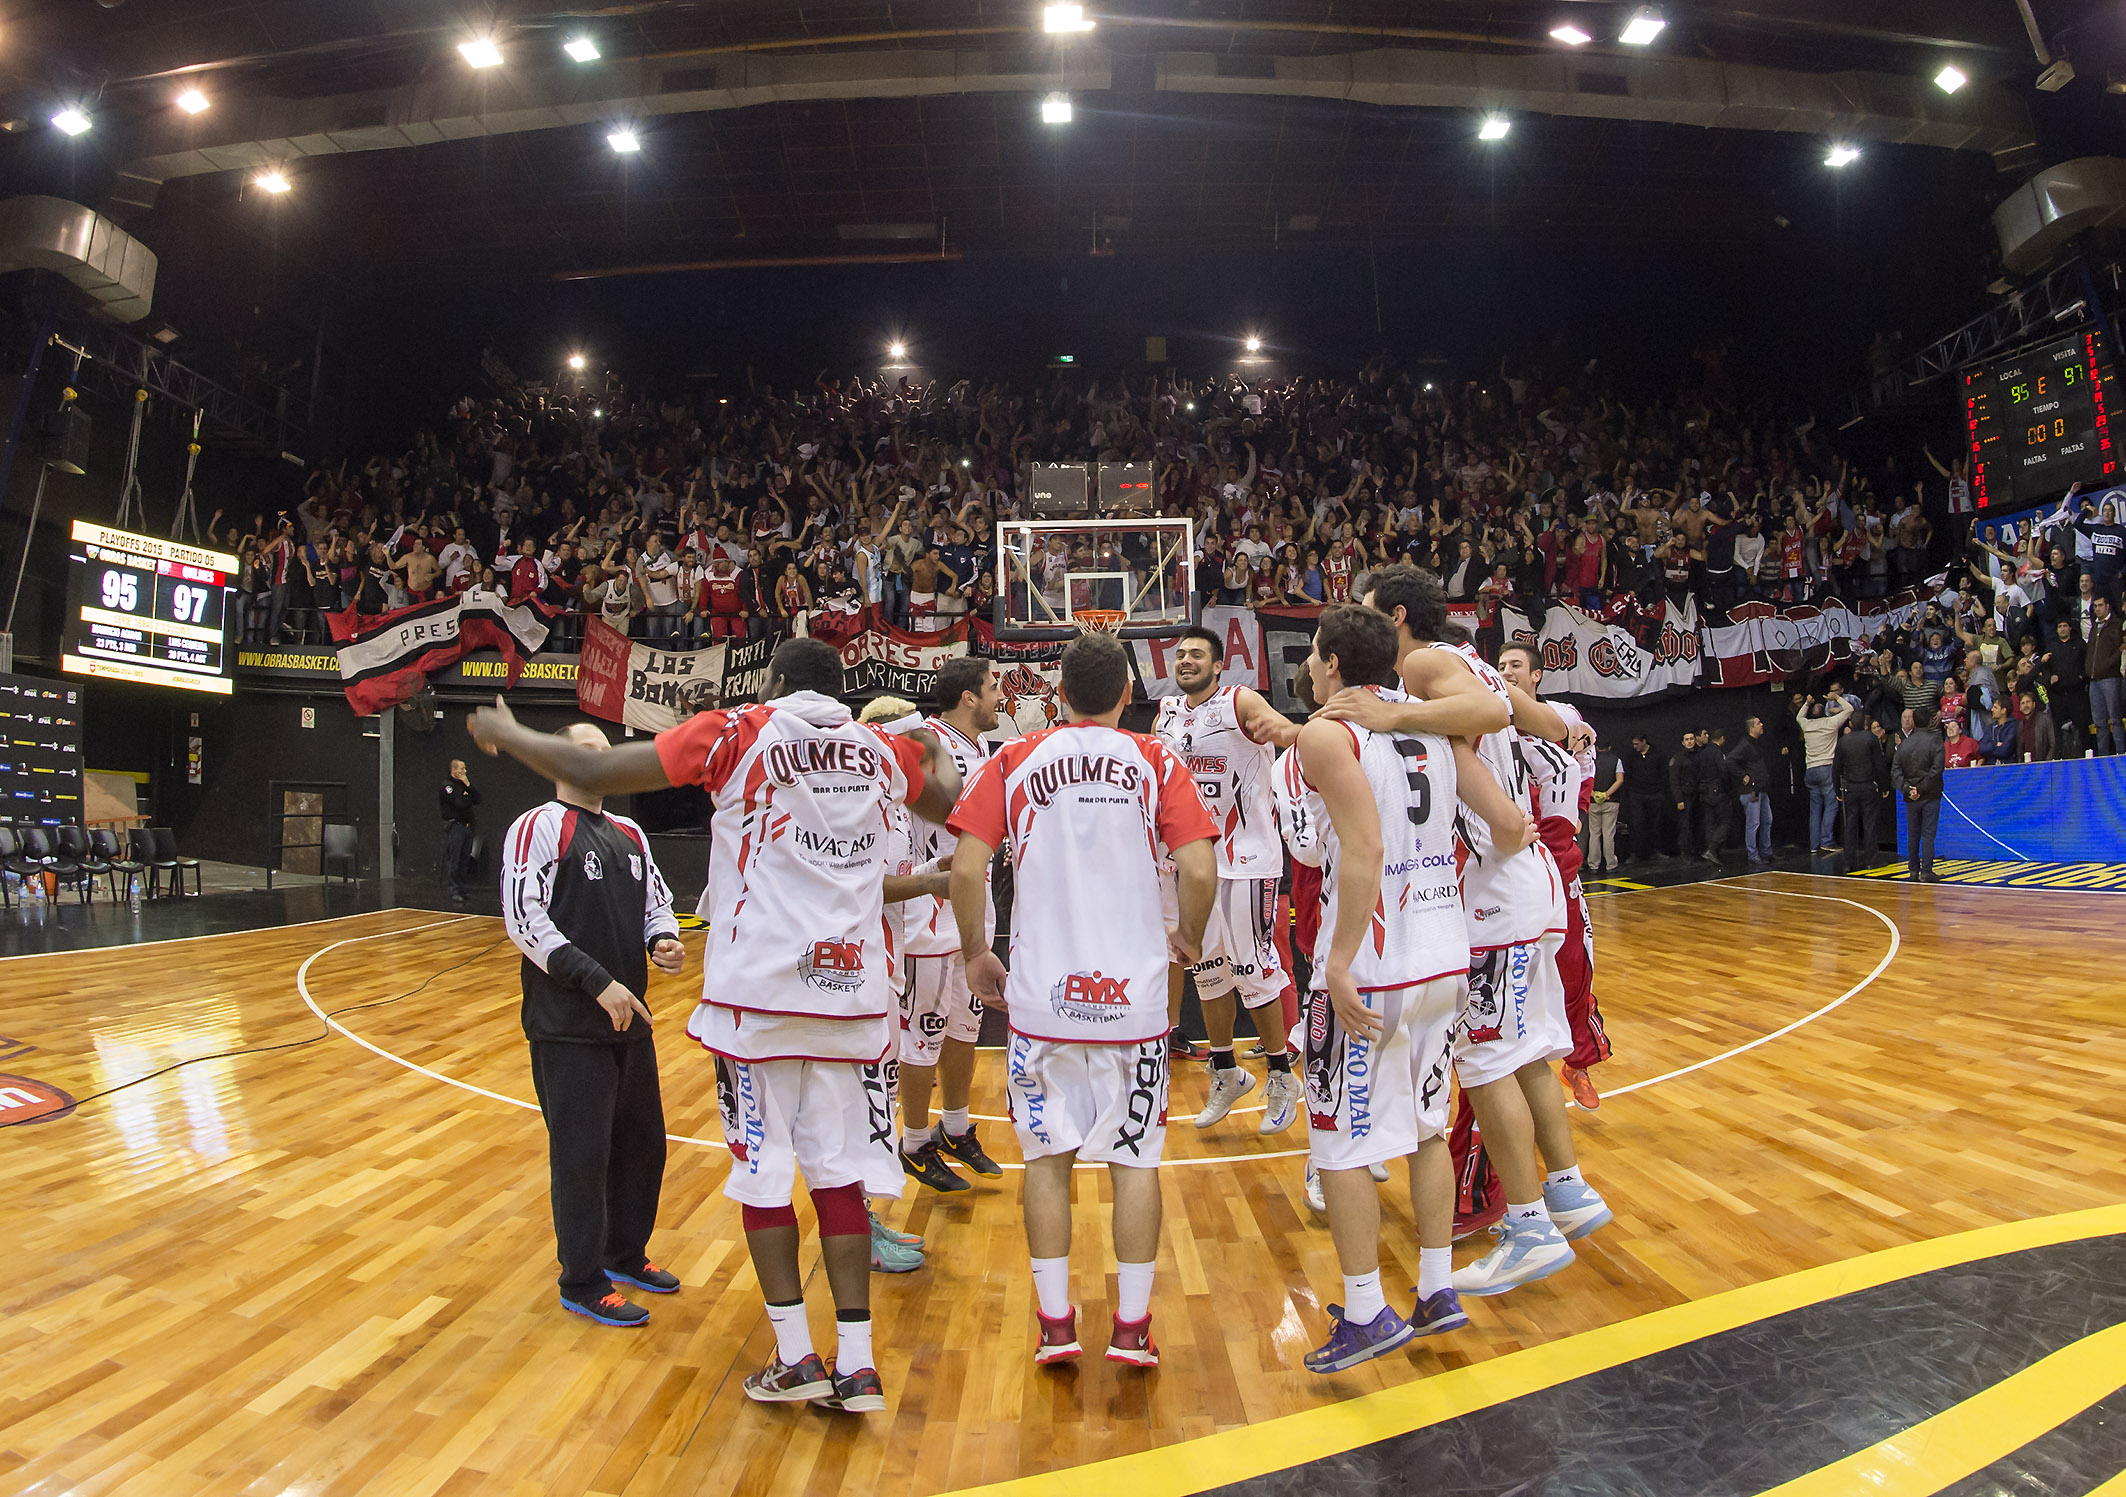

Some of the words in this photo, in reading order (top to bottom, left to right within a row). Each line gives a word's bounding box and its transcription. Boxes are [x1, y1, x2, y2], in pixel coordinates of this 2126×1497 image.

[2052, 348, 2077, 361] VISITA
[1999, 368, 2022, 381] LOCAL
[2064, 364, 2083, 386] 97
[2011, 383, 2030, 404] 95
[2037, 376, 2046, 395] E
[2032, 401, 2059, 415] TIEMPO
[2061, 442, 2085, 455] FALTAS
[2023, 453, 2047, 466] FALTAS
[100, 532, 140, 551] PLAYOFFS
[142, 542, 163, 556] 2015
[170, 547, 203, 564] PARTIDO
[204, 555, 215, 567] 05
[102, 570, 138, 611] 95
[173, 584, 208, 623] 97
[643, 652, 696, 675] LOS
[847, 785, 870, 793] PLATA
[1028, 755, 1139, 807] QUILMES
[1069, 1010, 1126, 1024] BASKETBALL
[1347, 1084, 1372, 1140] MAR
